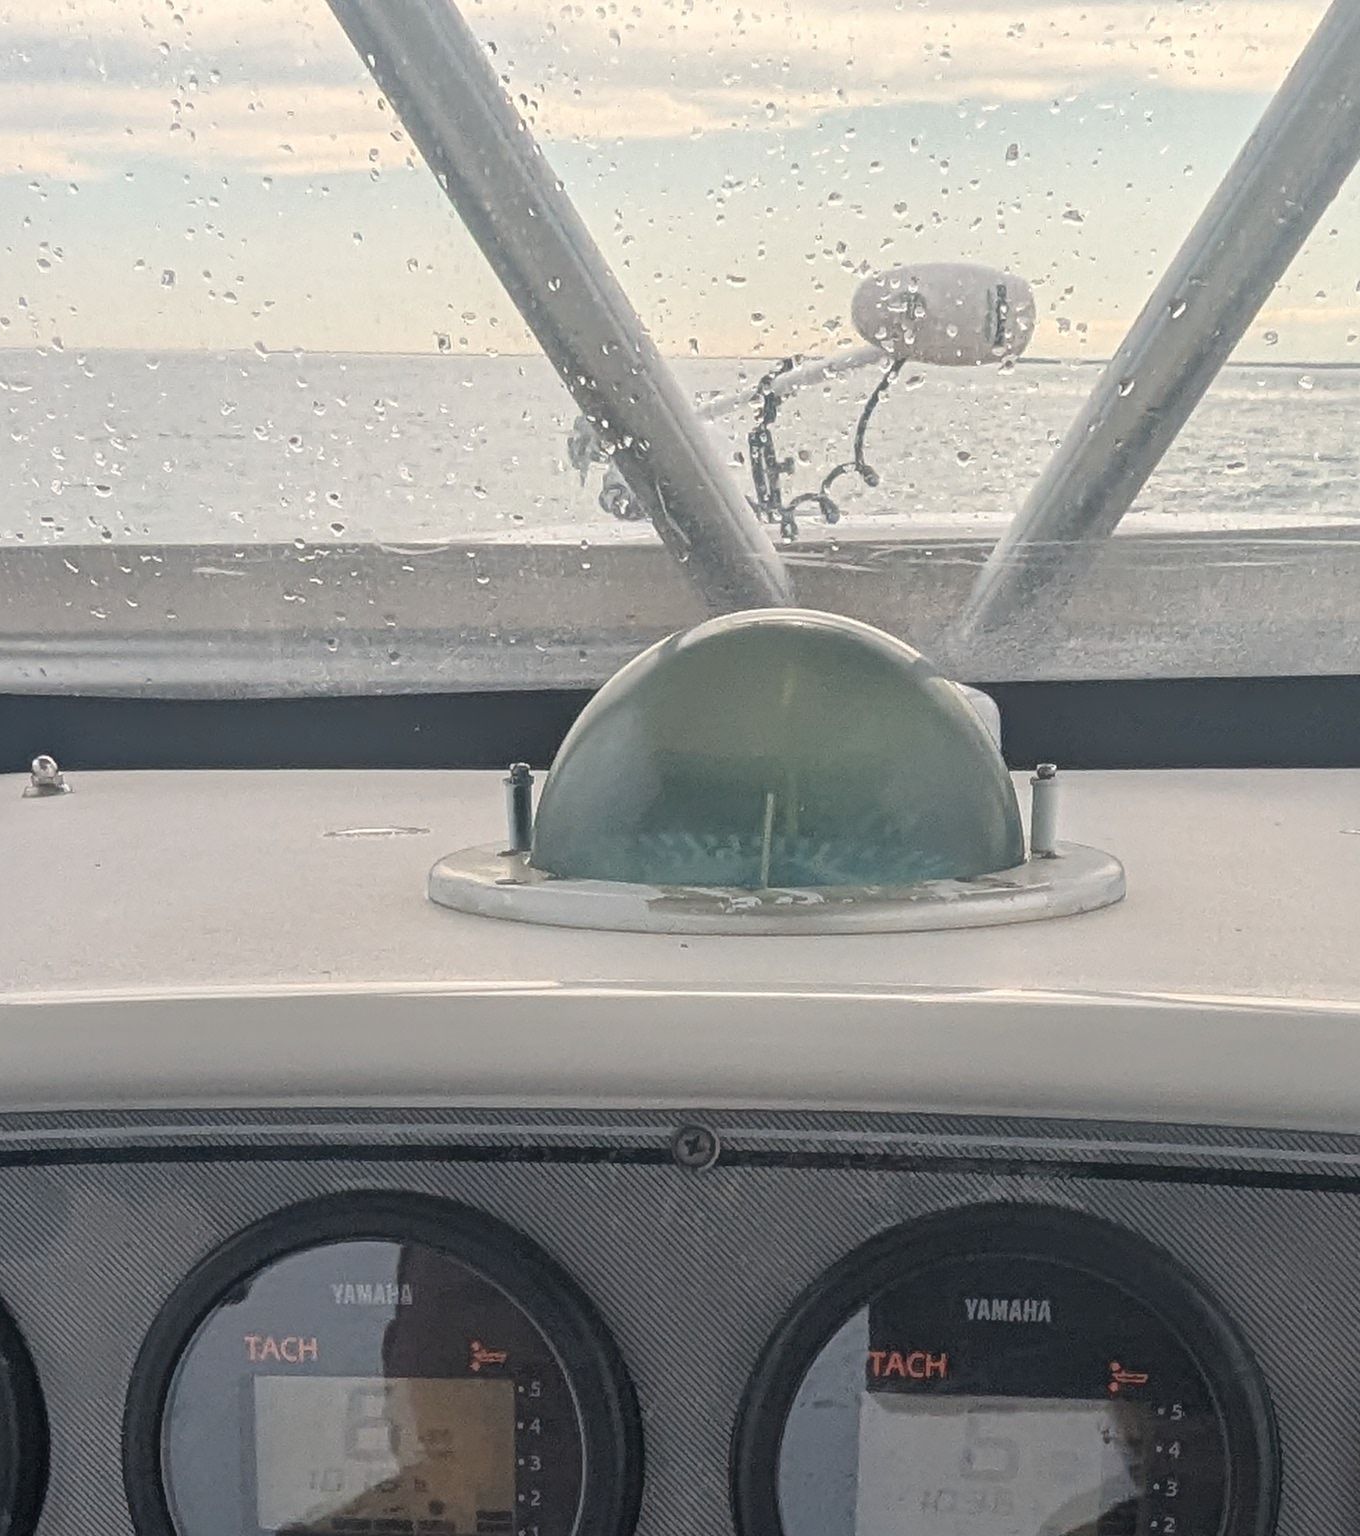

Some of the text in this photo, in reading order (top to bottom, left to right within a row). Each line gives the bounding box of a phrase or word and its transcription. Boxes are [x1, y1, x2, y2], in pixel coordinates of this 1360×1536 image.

[330, 1283, 413, 1306] YAMAHA
[964, 1298, 1052, 1323] YAMAHA
[243, 1335, 320, 1362] TACH
[868, 1351, 949, 1379] TACH
[527, 1380, 542, 1398] 5
[1169, 1404, 1185, 1421] 5
[527, 1417, 542, 1434] 4
[1167, 1441, 1181, 1459] 4
[528, 1455, 543, 1472] 3
[1165, 1480, 1179, 1497] 3
[529, 1490, 542, 1507] 2
[1162, 1516, 1176, 1534] 2
